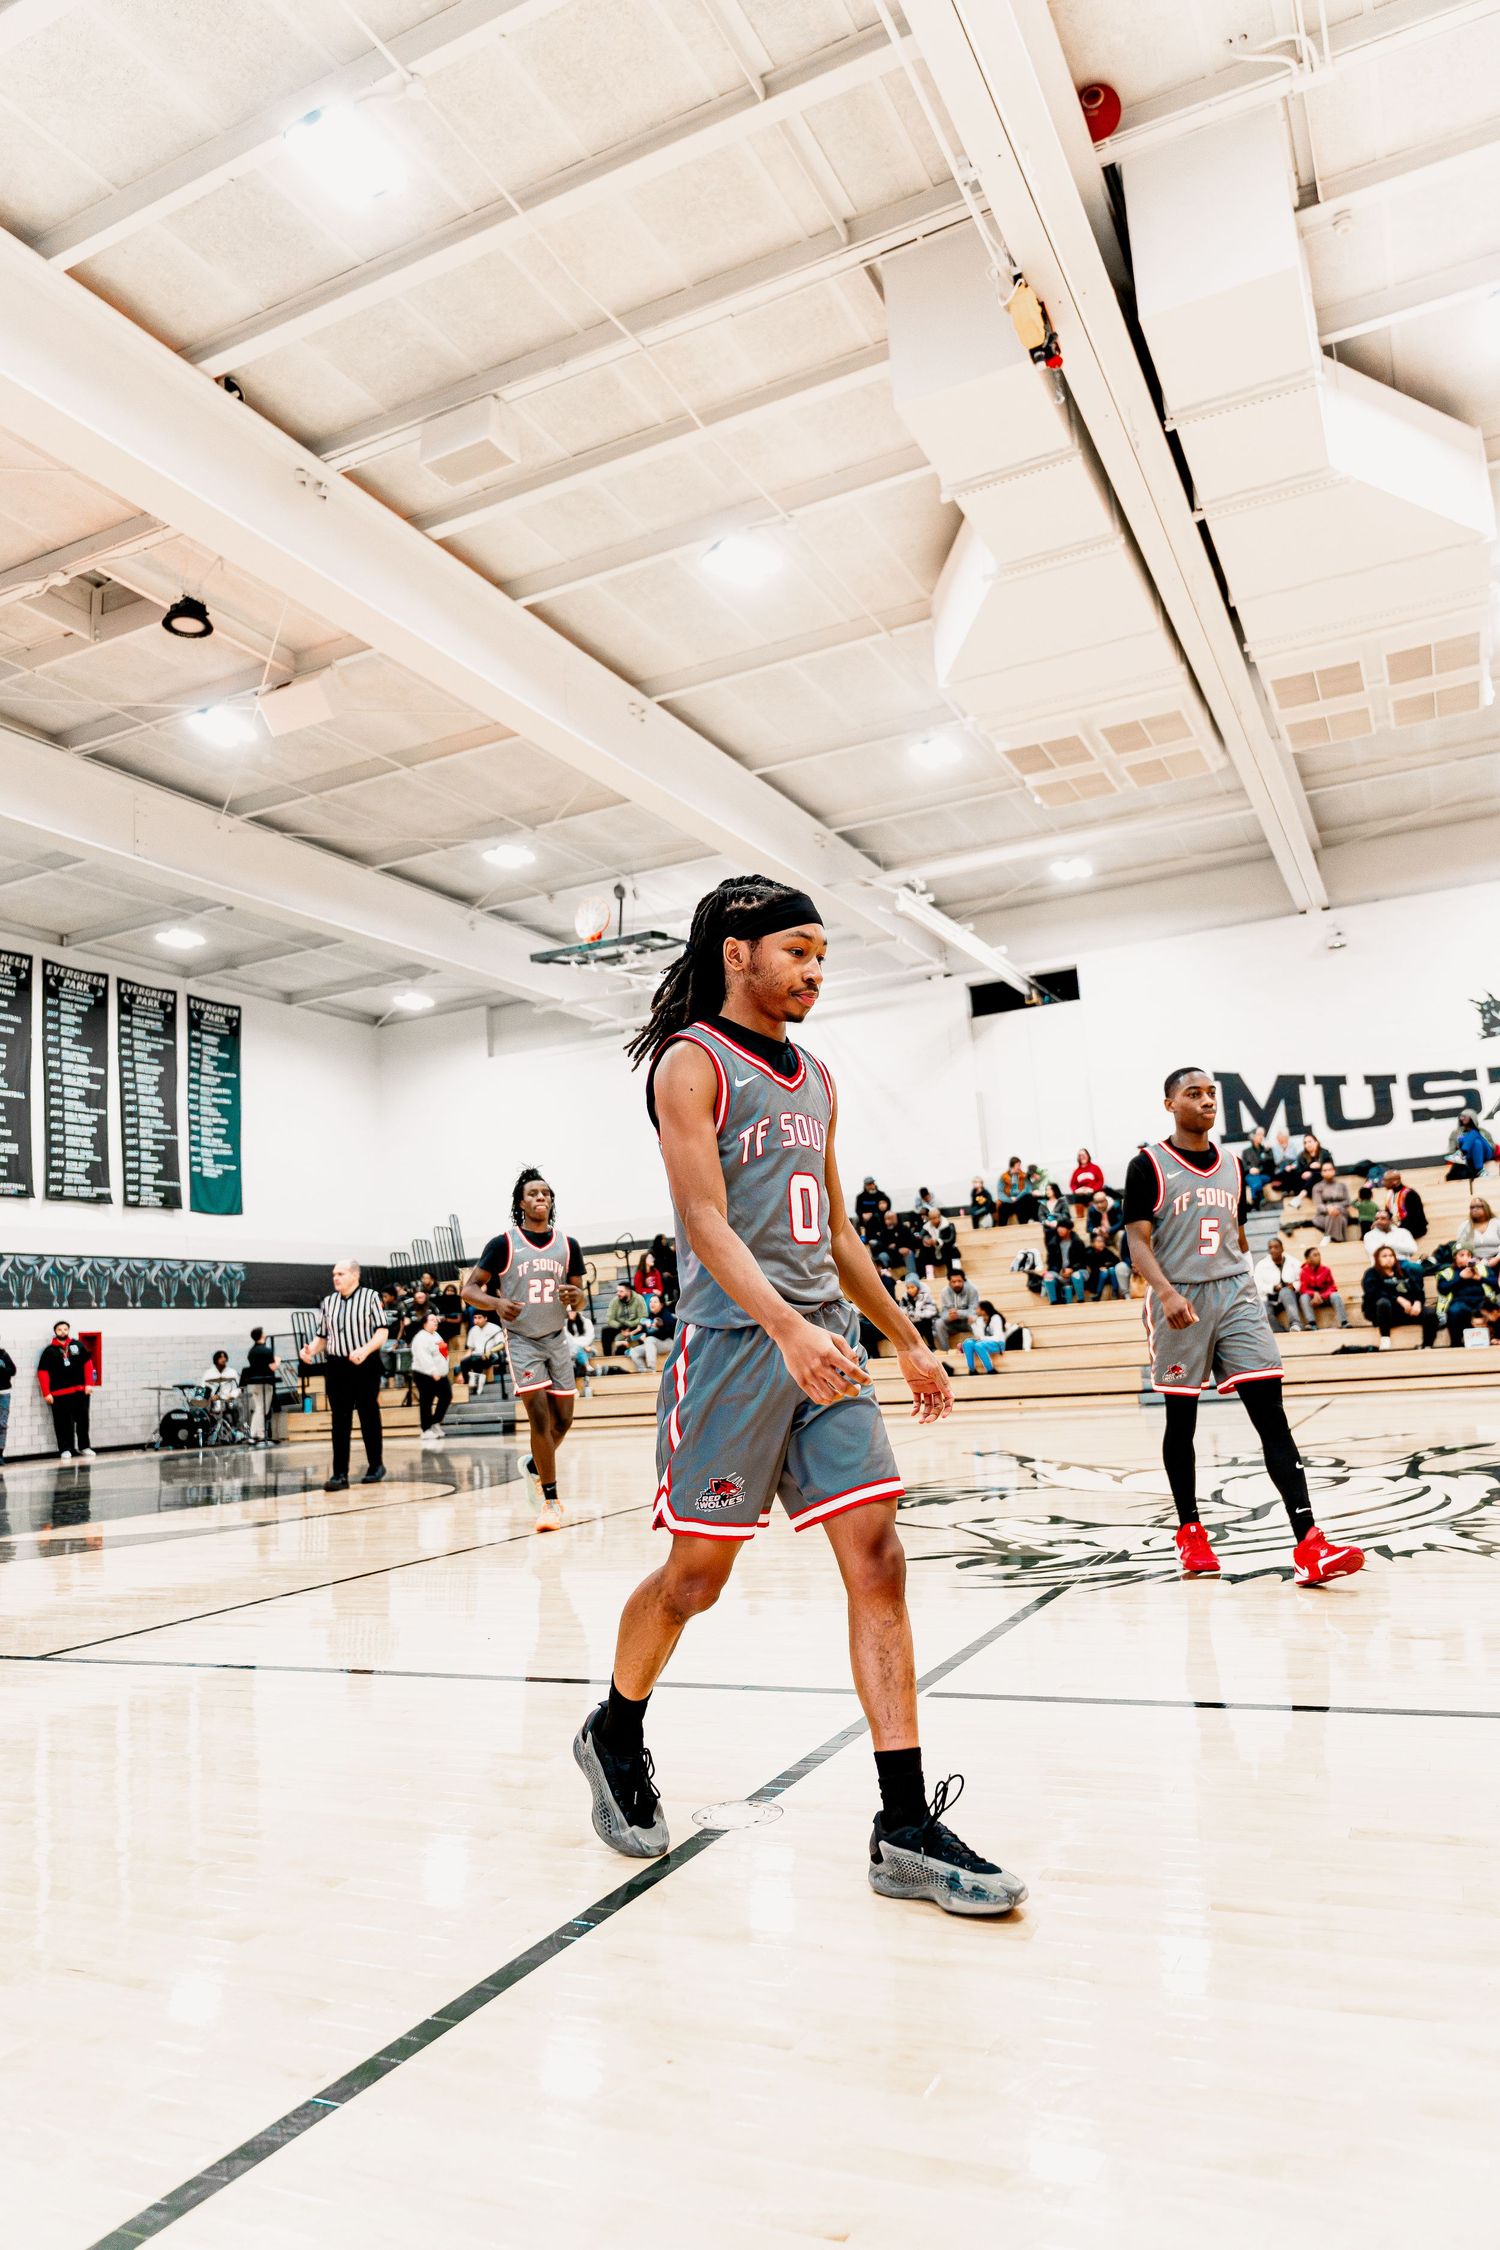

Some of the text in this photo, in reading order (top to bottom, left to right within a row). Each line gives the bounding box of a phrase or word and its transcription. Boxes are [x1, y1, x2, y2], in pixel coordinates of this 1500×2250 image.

[45, 964, 106, 988] EVERGREEN
[63, 978, 90, 992] PARK
[120, 982, 174, 1004] EVERGREEN
[136, 995, 160, 1008] PARK
[190, 999, 239, 1018] EVERGREEN
[203, 1012, 225, 1024] PARK
[1213, 1066, 1500, 1144] MUS
[738, 1116, 771, 1165] TF
[788, 1172, 823, 1245] 0
[1173, 1191, 1191, 1216] TF
[1199, 1217, 1220, 1256] 5
[517, 1258, 564, 1278] TF SOUTH
[528, 1278, 555, 1304] 22
[699, 1496, 743, 1509] WOLVES
